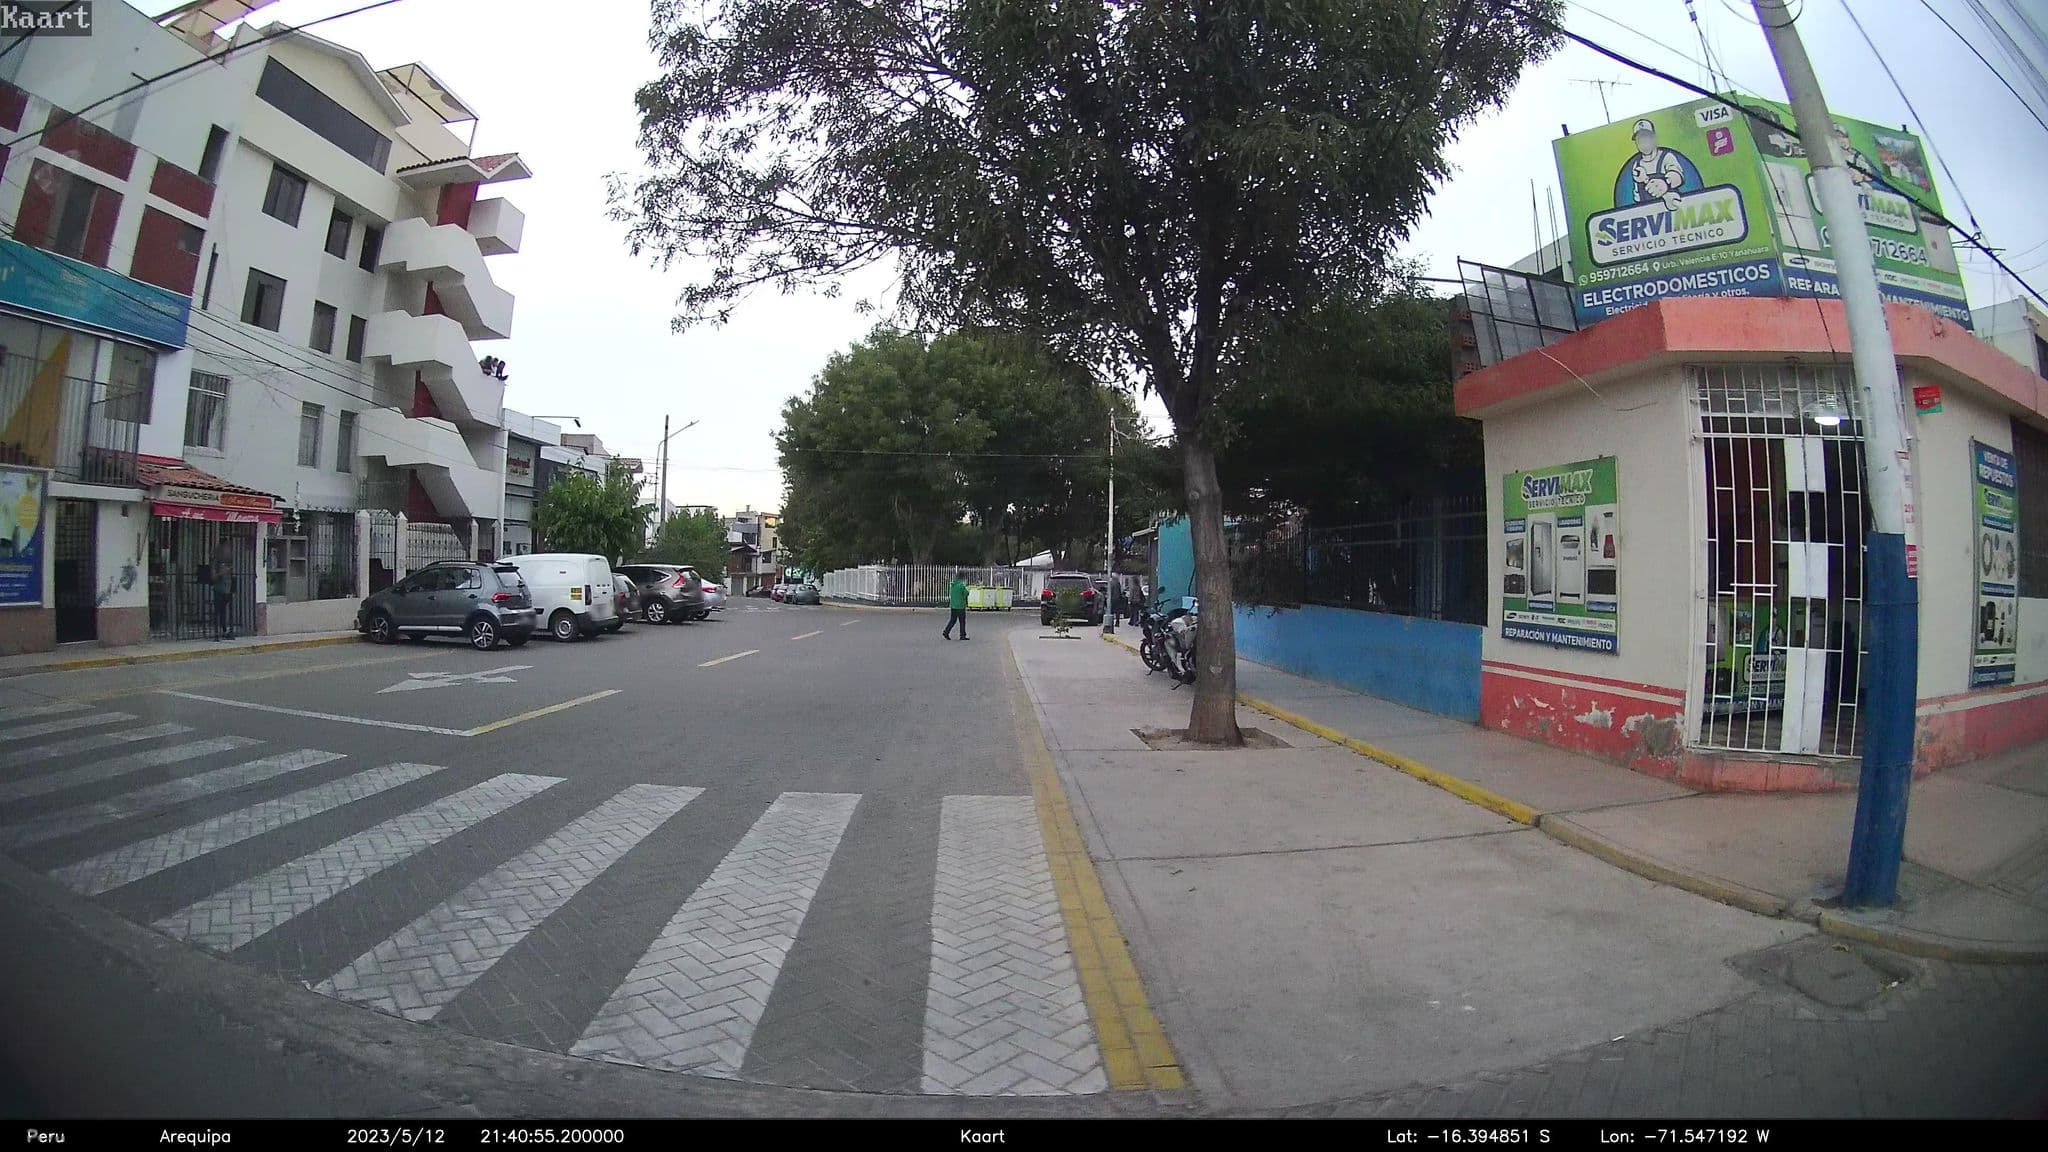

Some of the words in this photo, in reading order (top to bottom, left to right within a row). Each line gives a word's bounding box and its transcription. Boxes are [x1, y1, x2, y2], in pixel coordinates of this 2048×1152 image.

[1700, 106, 1730, 122] VISA
[1596, 197, 1735, 247] SERVIMAX
[1612, 239, 1667, 257] SERVICIO
[1672, 228, 1725, 245] TECNICO
[1589, 262, 1650, 284] 959712664
[1662, 259, 1679, 270] Urb.
[1679, 254, 1711, 267] Valencia
[1729, 246, 1769, 259] Yanahuara
[1582, 264, 1771, 308] ELECTRODOMESTICOS
[1721, 287, 1751, 298] otros.
[1522, 470, 1593, 499] SERVIMAX
[1504, 627, 1545, 641] REPARACIÓN
[1546, 632, 1551, 642] Y
[1551, 634, 1612, 650] MANTENIMIENTO
